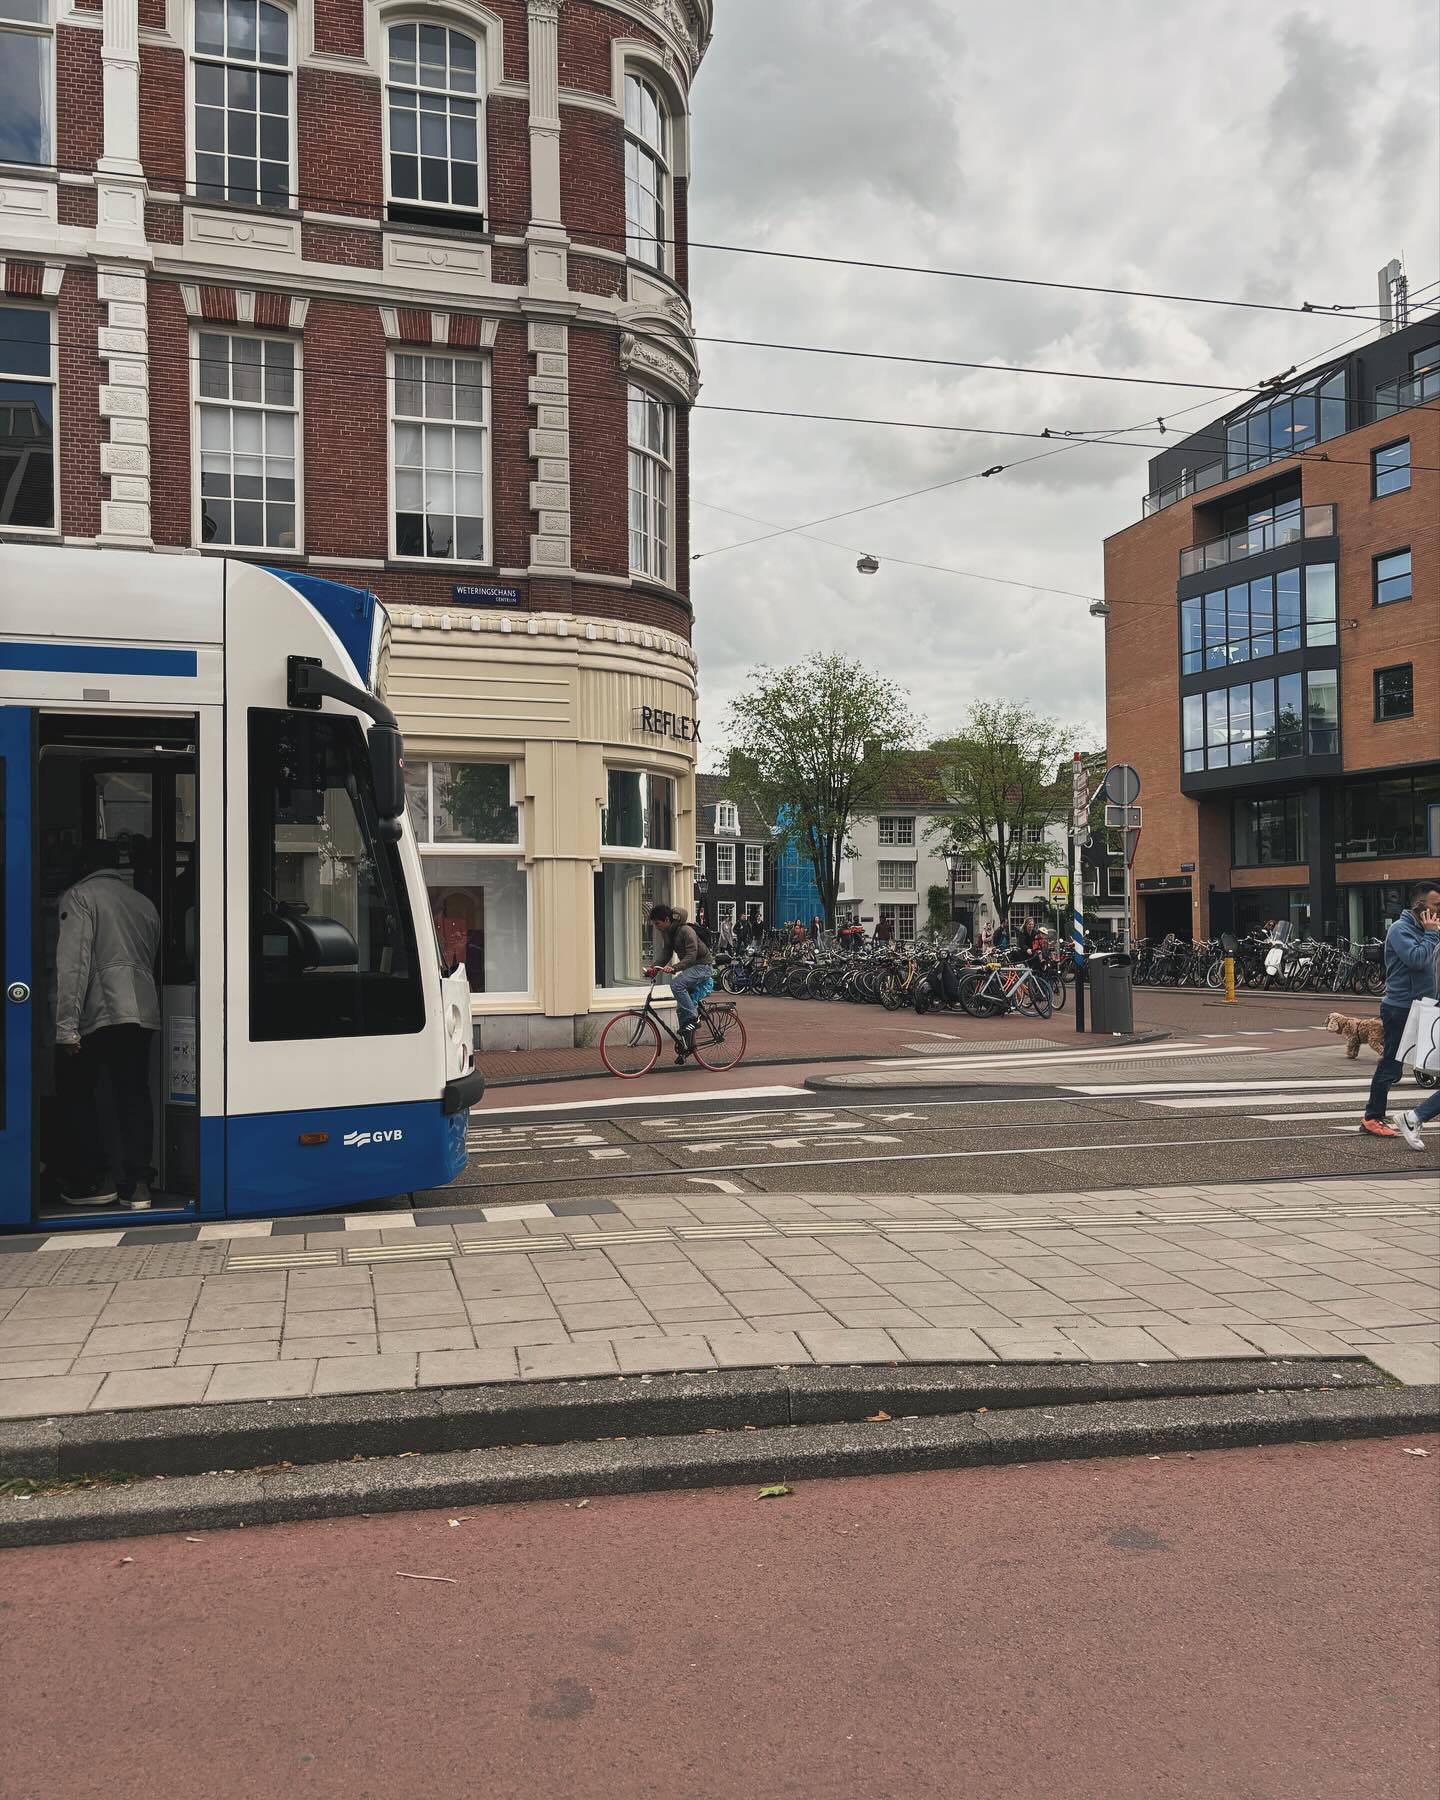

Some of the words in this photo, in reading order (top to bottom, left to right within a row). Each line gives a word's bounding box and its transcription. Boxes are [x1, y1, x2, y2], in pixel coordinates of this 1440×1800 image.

[456, 586, 516, 597] WETERINGSCHANS
[642, 705, 702, 743] REFLEX
[372, 1129, 403, 1143] GVB
